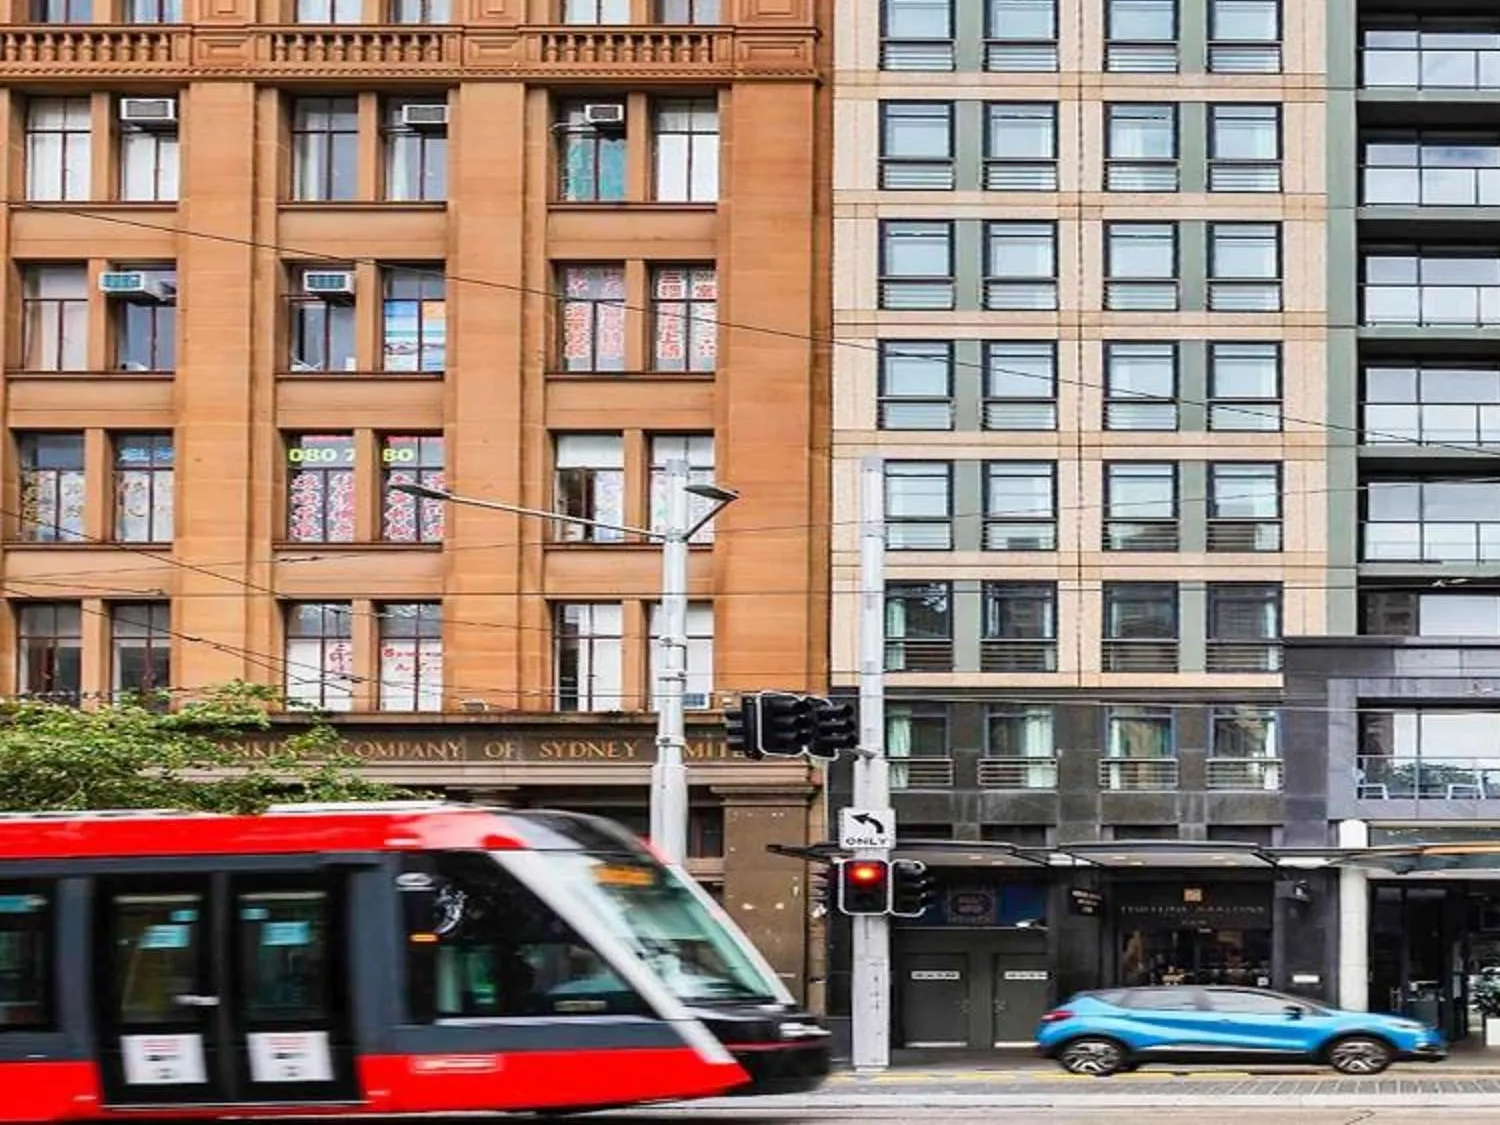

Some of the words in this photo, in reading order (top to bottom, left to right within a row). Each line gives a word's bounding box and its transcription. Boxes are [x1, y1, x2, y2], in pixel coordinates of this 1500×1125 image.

[289, 447, 338, 463] 080
[336, 739, 466, 759] COMPANY
[484, 740, 518, 759] OF
[538, 740, 638, 759] SYDNEY
[845, 837, 888, 846] ONLY
